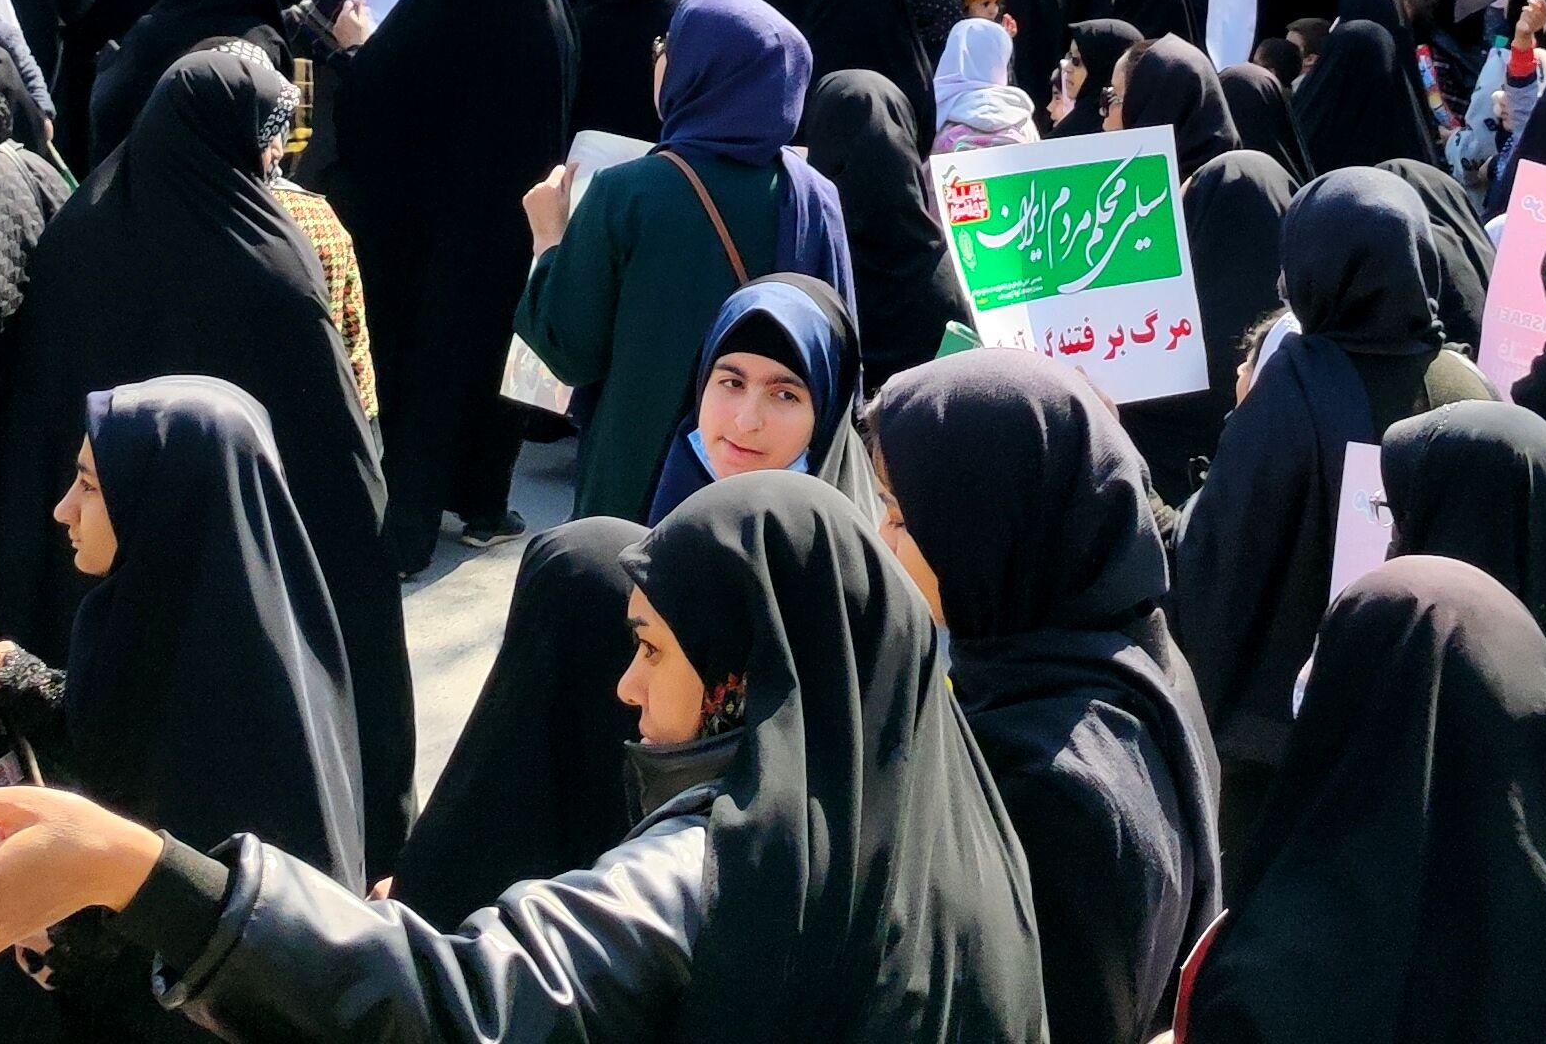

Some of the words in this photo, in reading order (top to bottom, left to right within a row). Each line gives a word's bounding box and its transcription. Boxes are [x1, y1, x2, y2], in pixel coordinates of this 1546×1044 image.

[975, 179, 1048, 263] ایران
[1047, 186, 1093, 270] مردم
[1057, 184, 1170, 296] سیلی
[1084, 145, 1144, 268] محکم
[1058, 316, 1096, 357] فتنه
[1103, 322, 1127, 361] بر
[1129, 307, 1193, 351] مرگ
